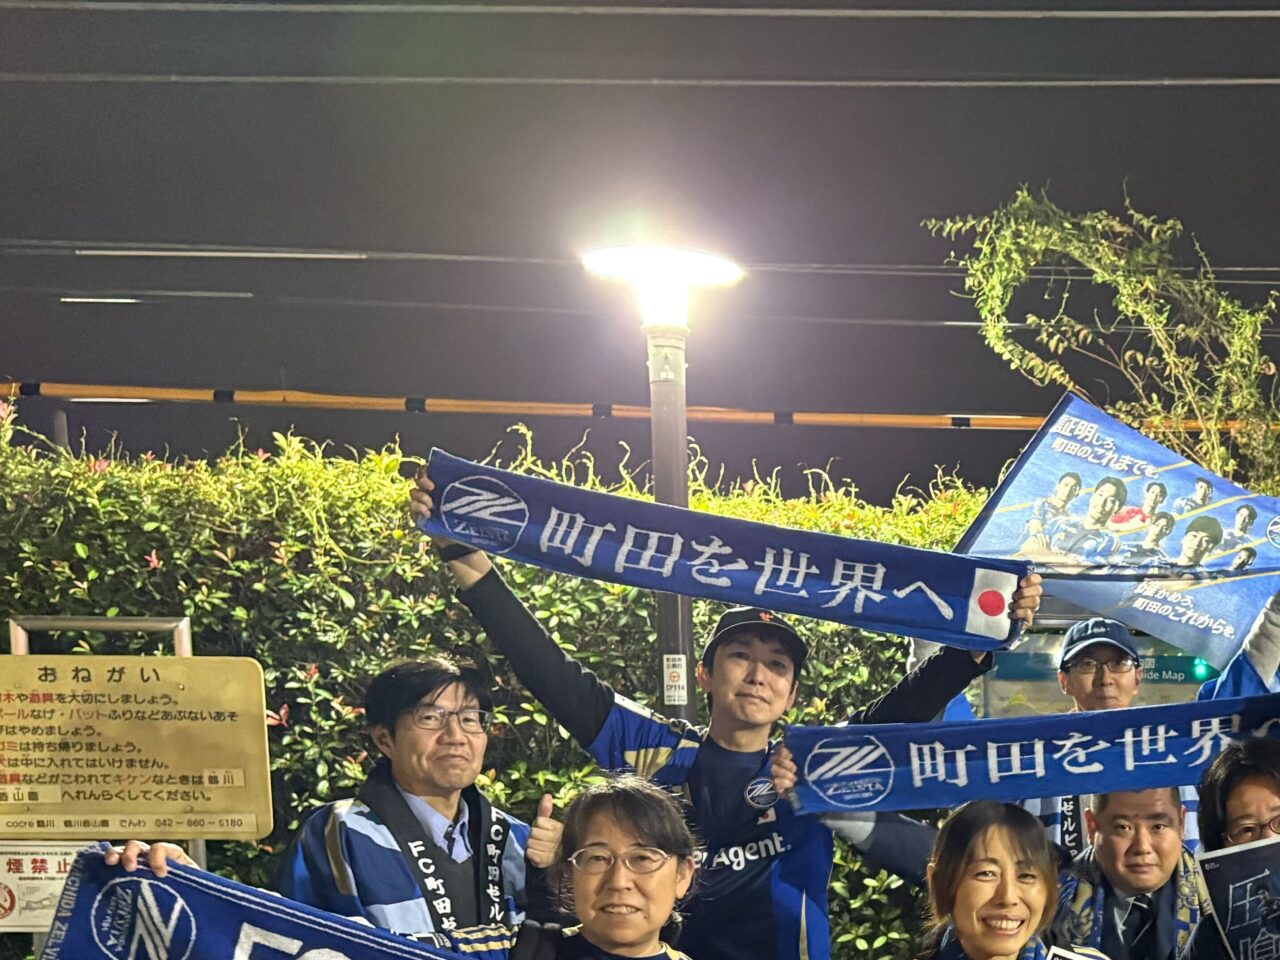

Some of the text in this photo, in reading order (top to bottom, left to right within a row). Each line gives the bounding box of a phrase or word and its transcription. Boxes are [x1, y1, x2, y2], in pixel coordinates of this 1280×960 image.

[539, 505, 954, 621] 町田を世界へ
[37, 666, 161, 683] おねがい
[1162, 671, 1184, 681] Map
[0, 692, 178, 705] 木や遊具を大切にしましょう。
